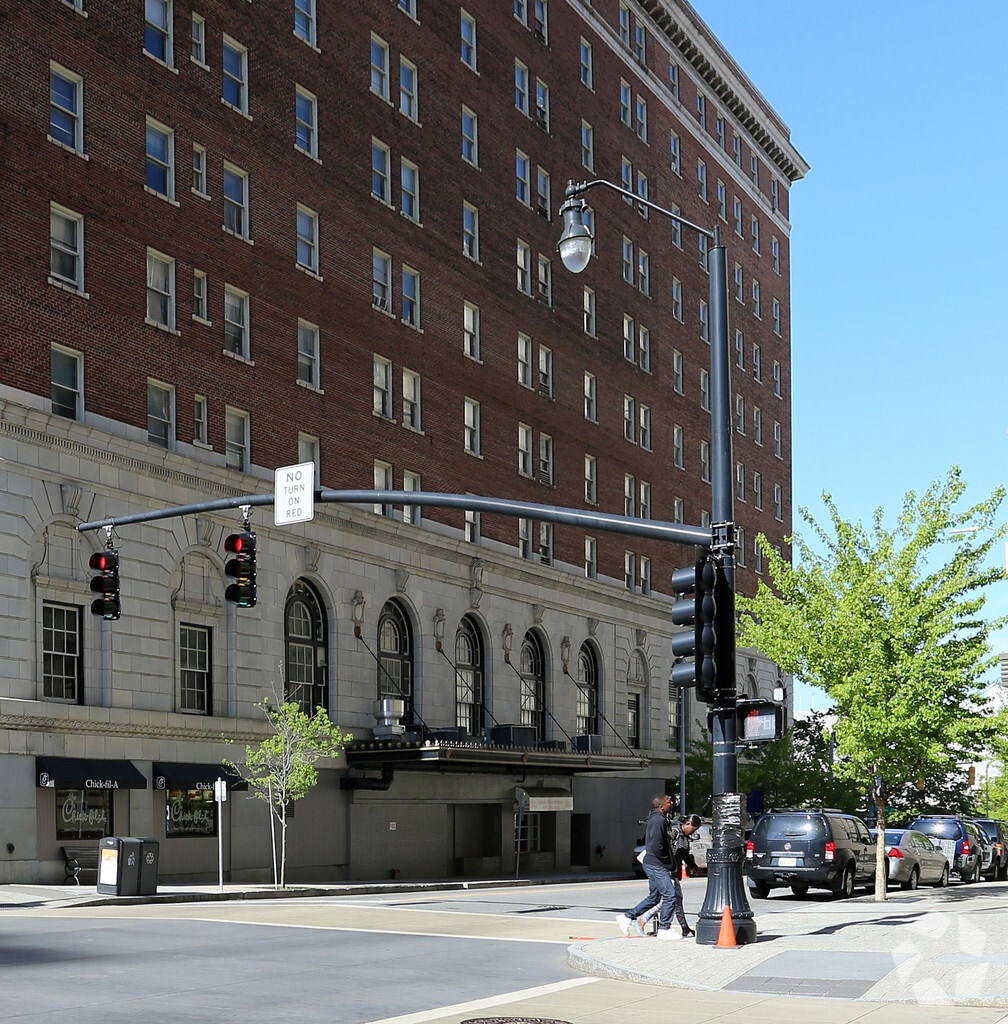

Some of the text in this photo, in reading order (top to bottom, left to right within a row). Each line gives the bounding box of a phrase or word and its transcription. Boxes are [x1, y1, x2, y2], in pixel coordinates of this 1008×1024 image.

[286, 471, 302, 482] NO
[284, 484, 305, 494] TURN
[288, 496, 299, 505] ON
[286, 508, 302, 518] RED
[85, 779, 119, 789] Chick-fil-A
